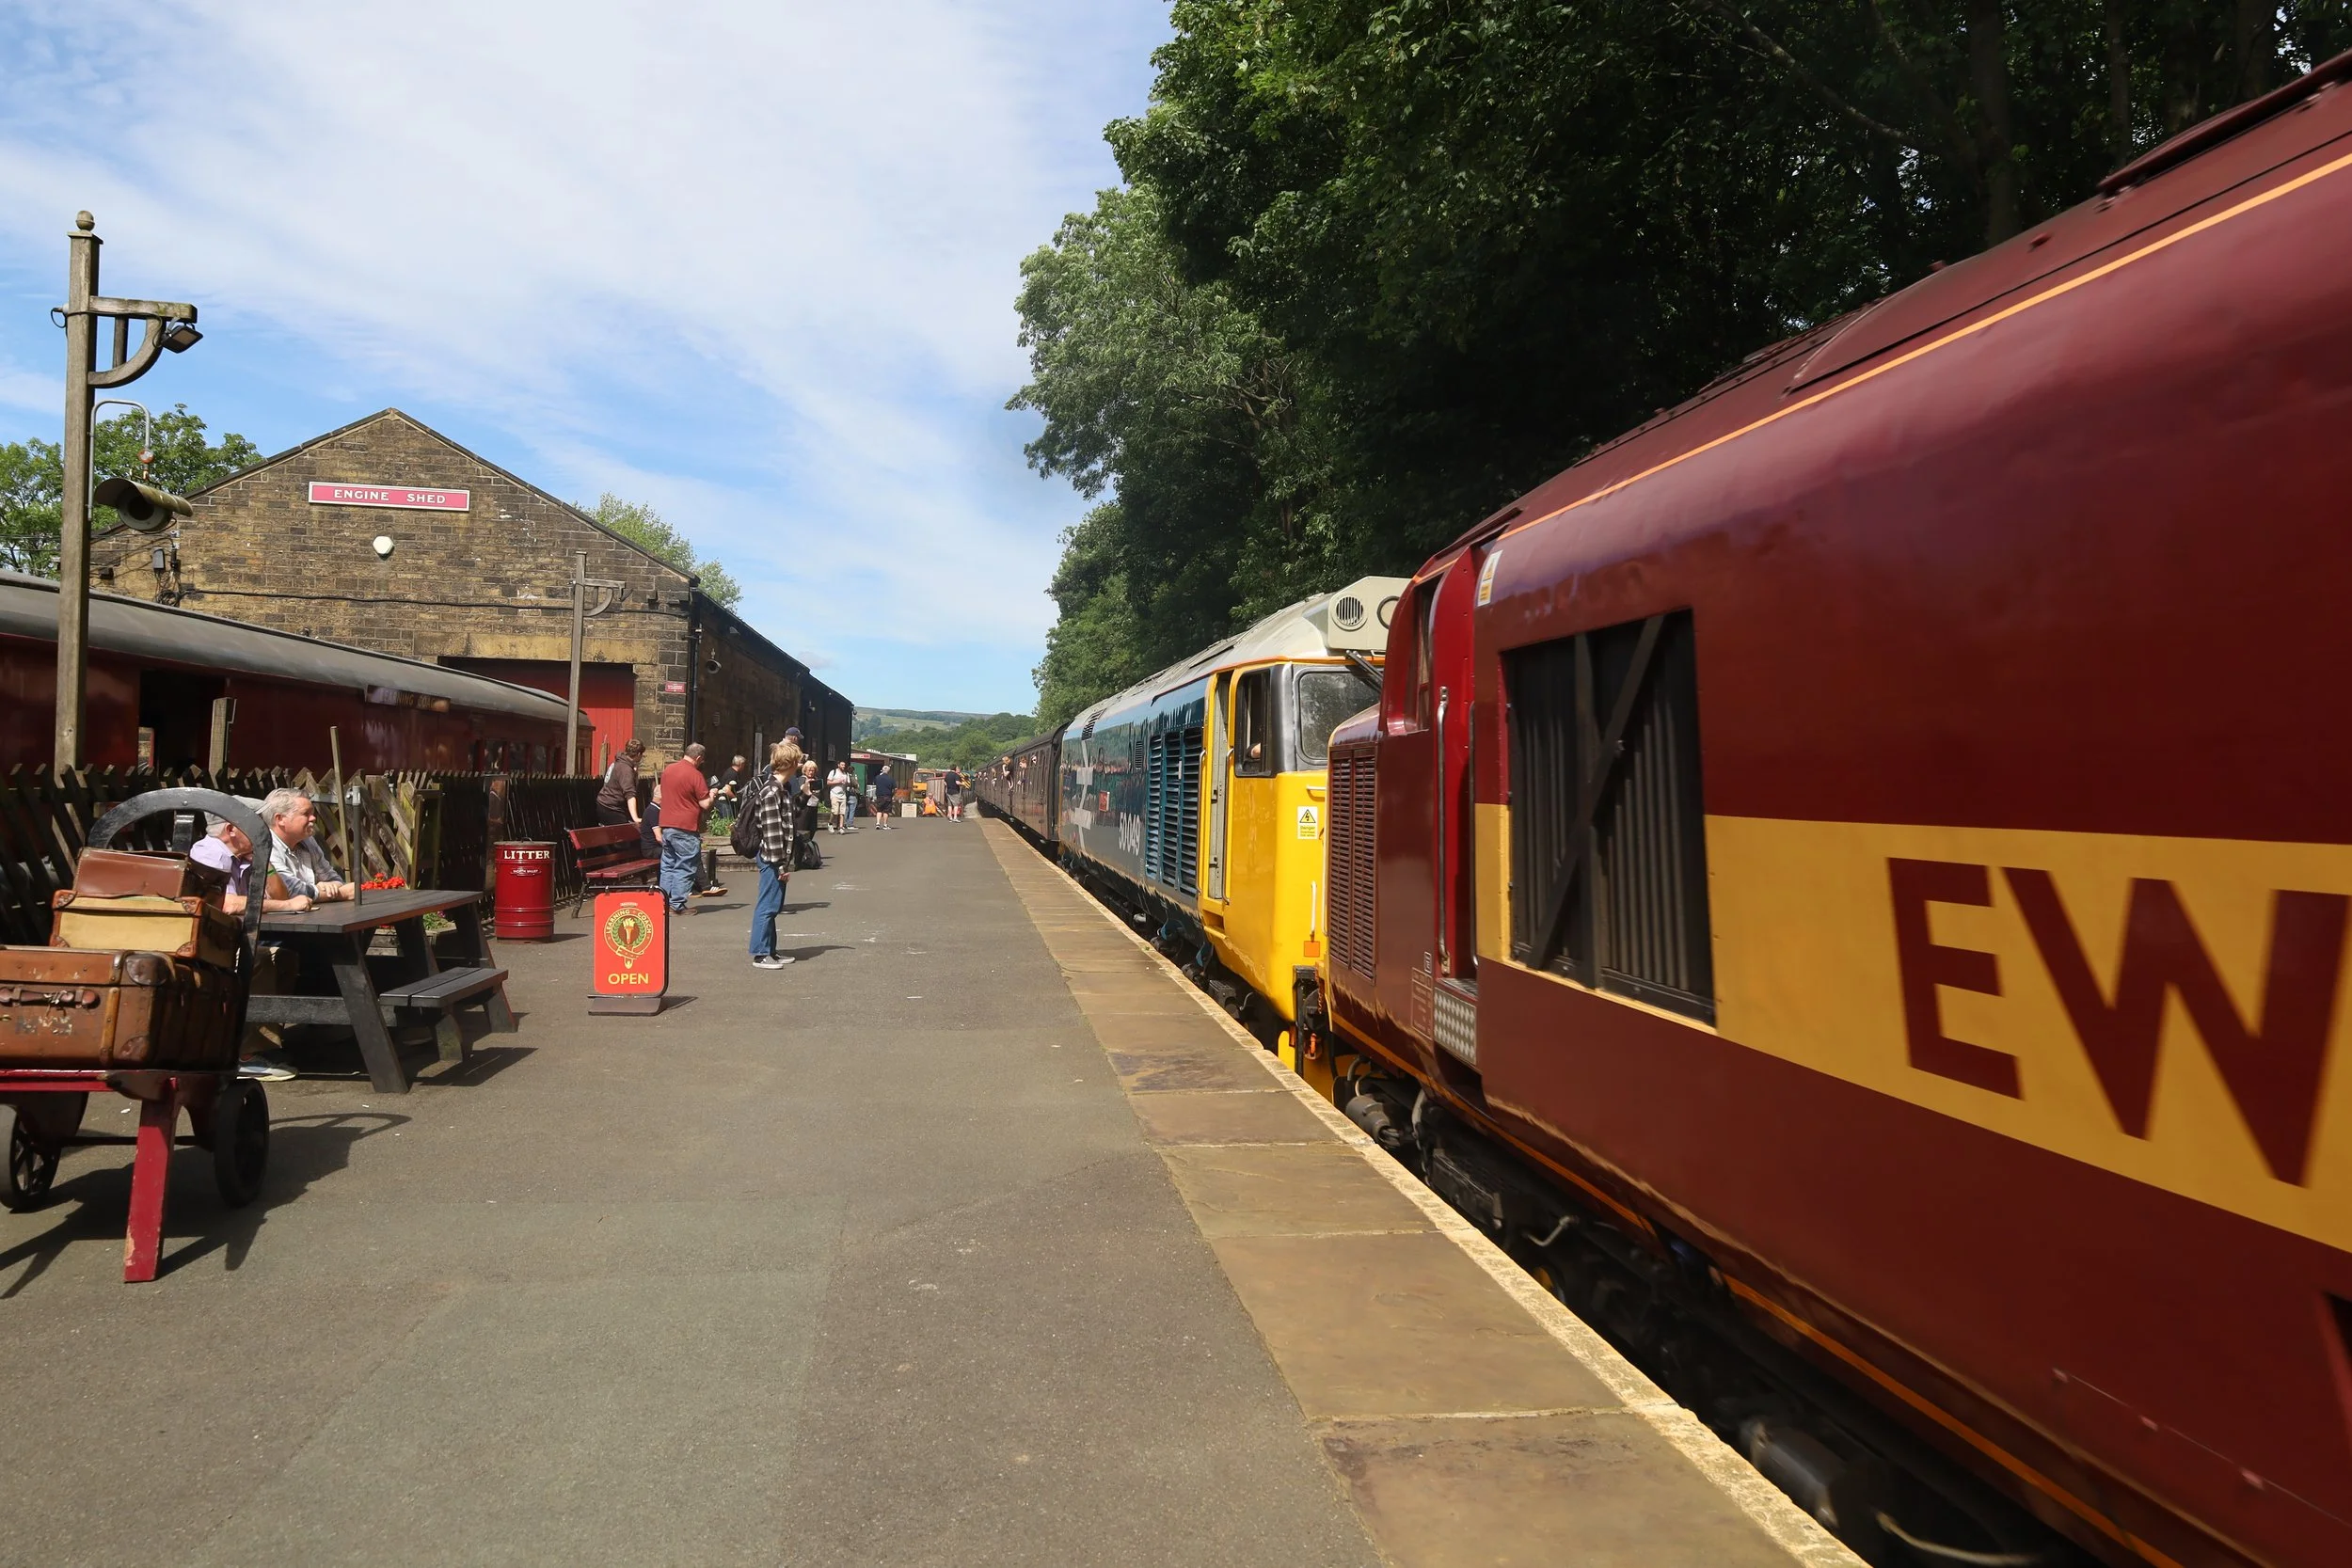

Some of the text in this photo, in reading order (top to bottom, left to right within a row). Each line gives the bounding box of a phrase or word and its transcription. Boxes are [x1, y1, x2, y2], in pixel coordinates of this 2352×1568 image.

[334, 489, 446, 504] ENGINE SHED
[417, 694, 438, 710] COAC
[503, 850, 550, 860] LITTER
[606, 909, 652, 934] LEARNING COACH
[608, 973, 649, 985] OPEN
[1886, 857, 2351, 1190] EW
